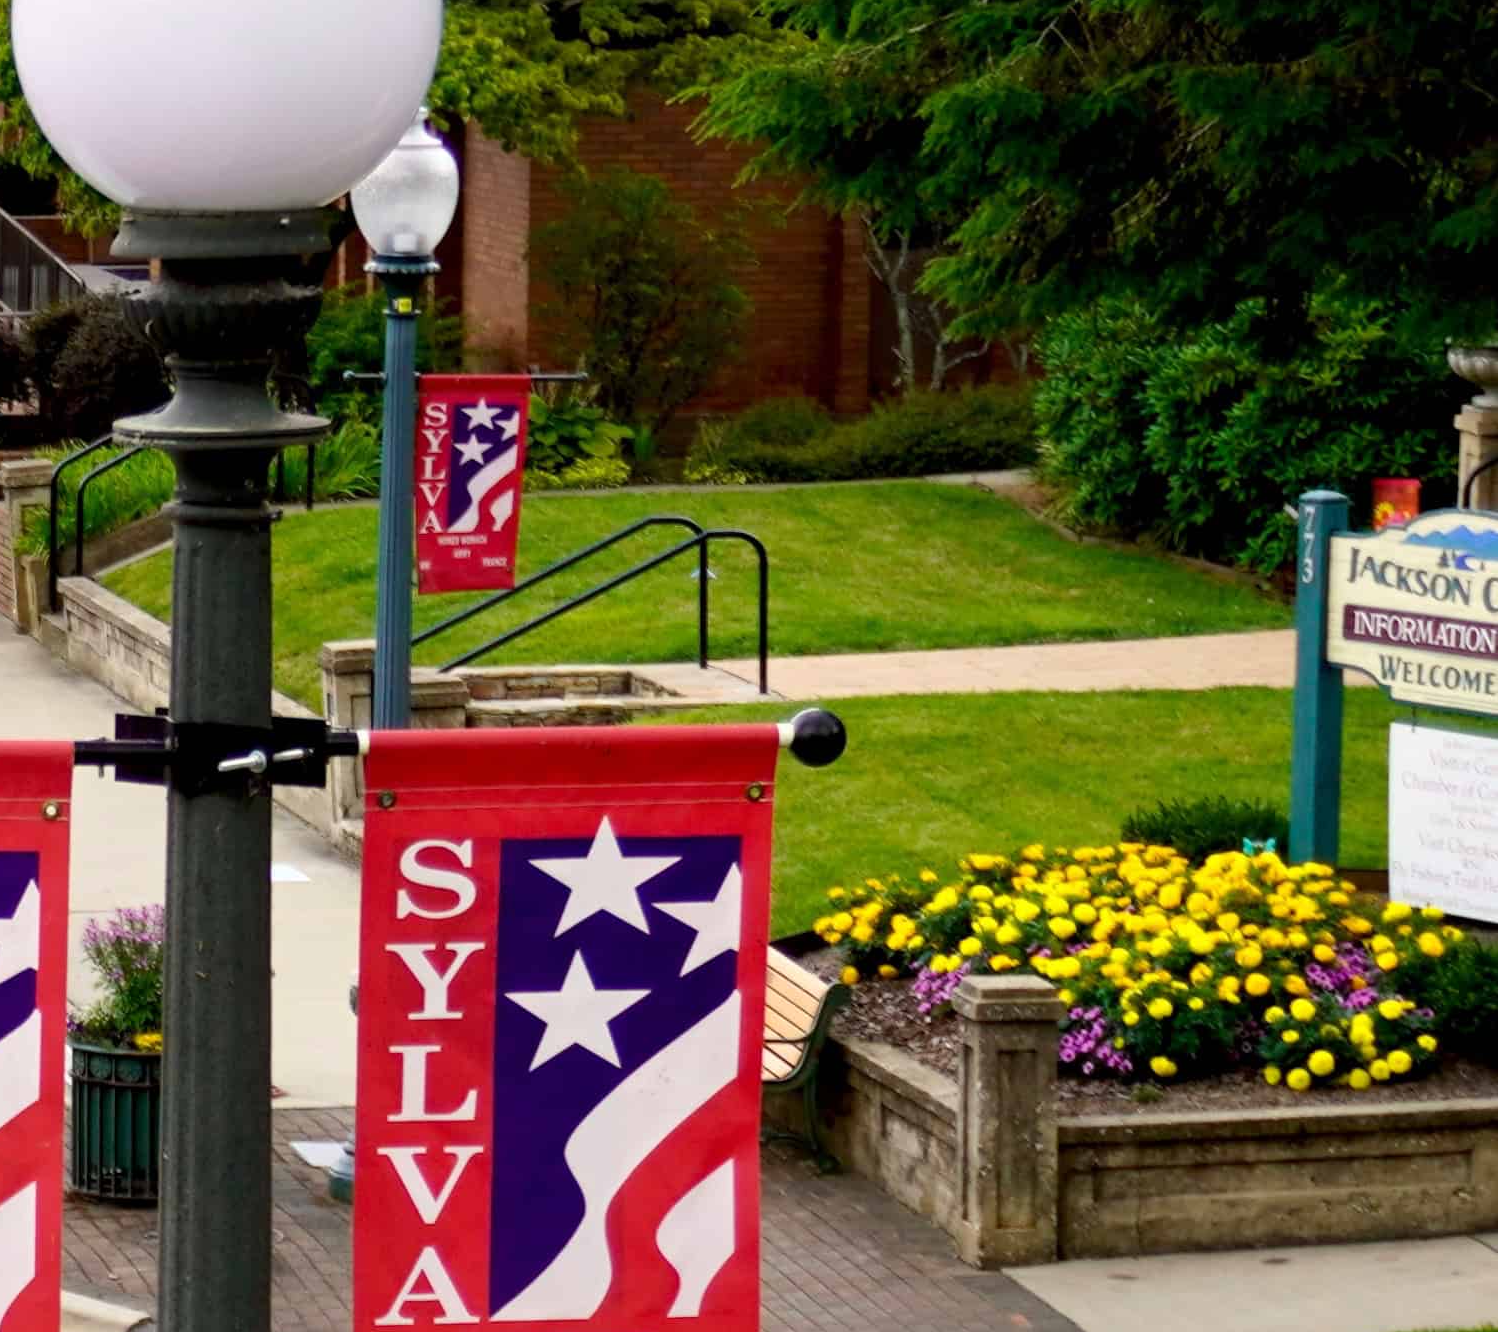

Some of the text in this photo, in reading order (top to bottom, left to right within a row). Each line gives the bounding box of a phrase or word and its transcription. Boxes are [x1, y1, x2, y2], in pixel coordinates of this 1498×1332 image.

[418, 402, 450, 535] SYLVA
[1301, 506, 1316, 584] 773
[1346, 547, 1471, 606] JACKSON
[1353, 609, 1498, 654] INFORMATION
[1378, 653, 1497, 696] WELCOME
[373, 838, 487, 1327] SYLVA
